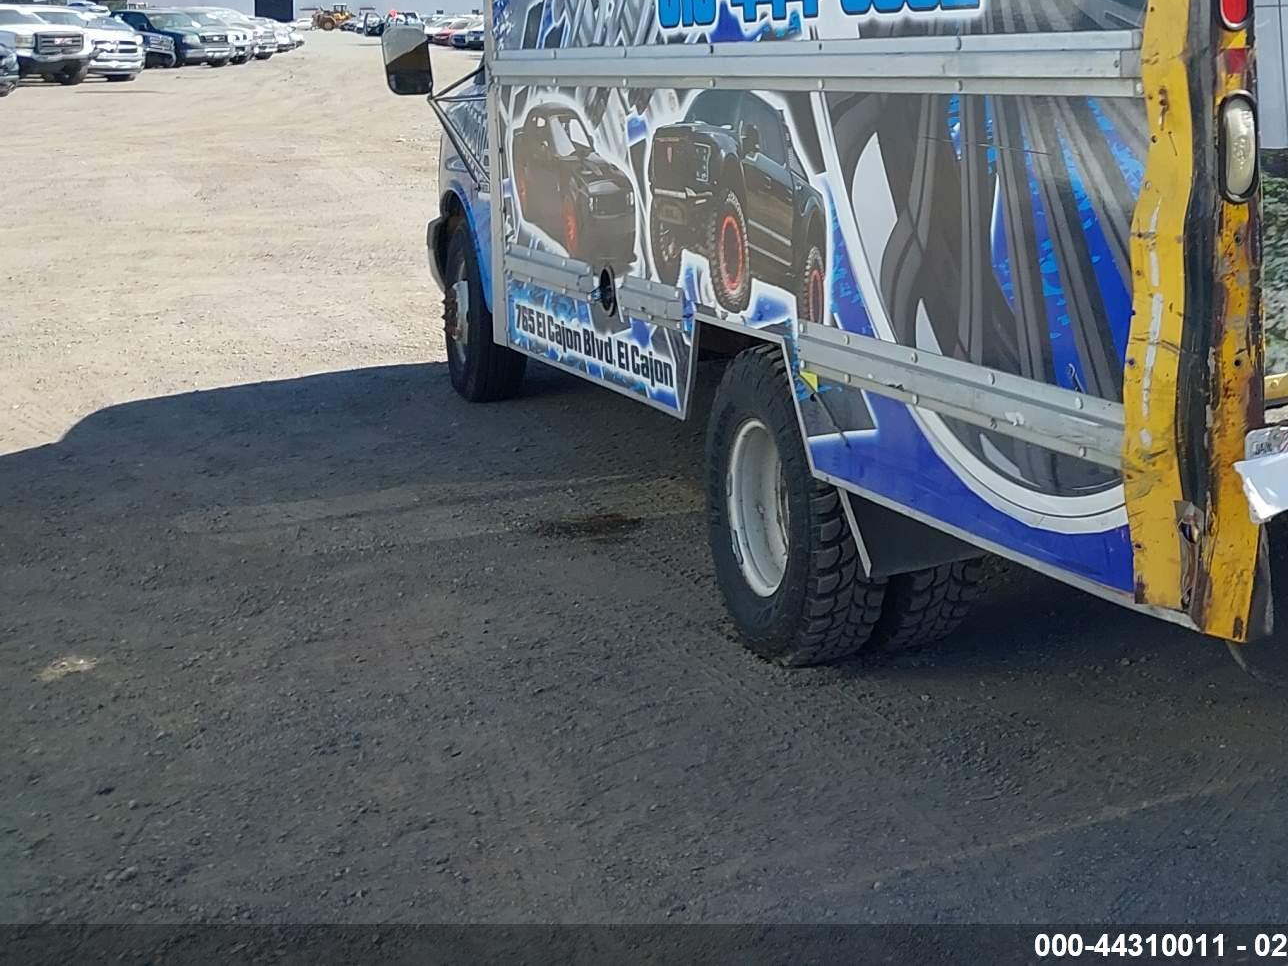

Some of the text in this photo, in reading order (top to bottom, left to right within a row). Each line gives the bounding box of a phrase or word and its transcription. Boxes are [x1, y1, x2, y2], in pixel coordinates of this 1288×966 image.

[515, 304, 535, 333] 765
[536, 312, 547, 339] El
[547, 315, 583, 353] Cajon
[617, 342, 629, 372] El
[631, 347, 674, 388] Cajon
